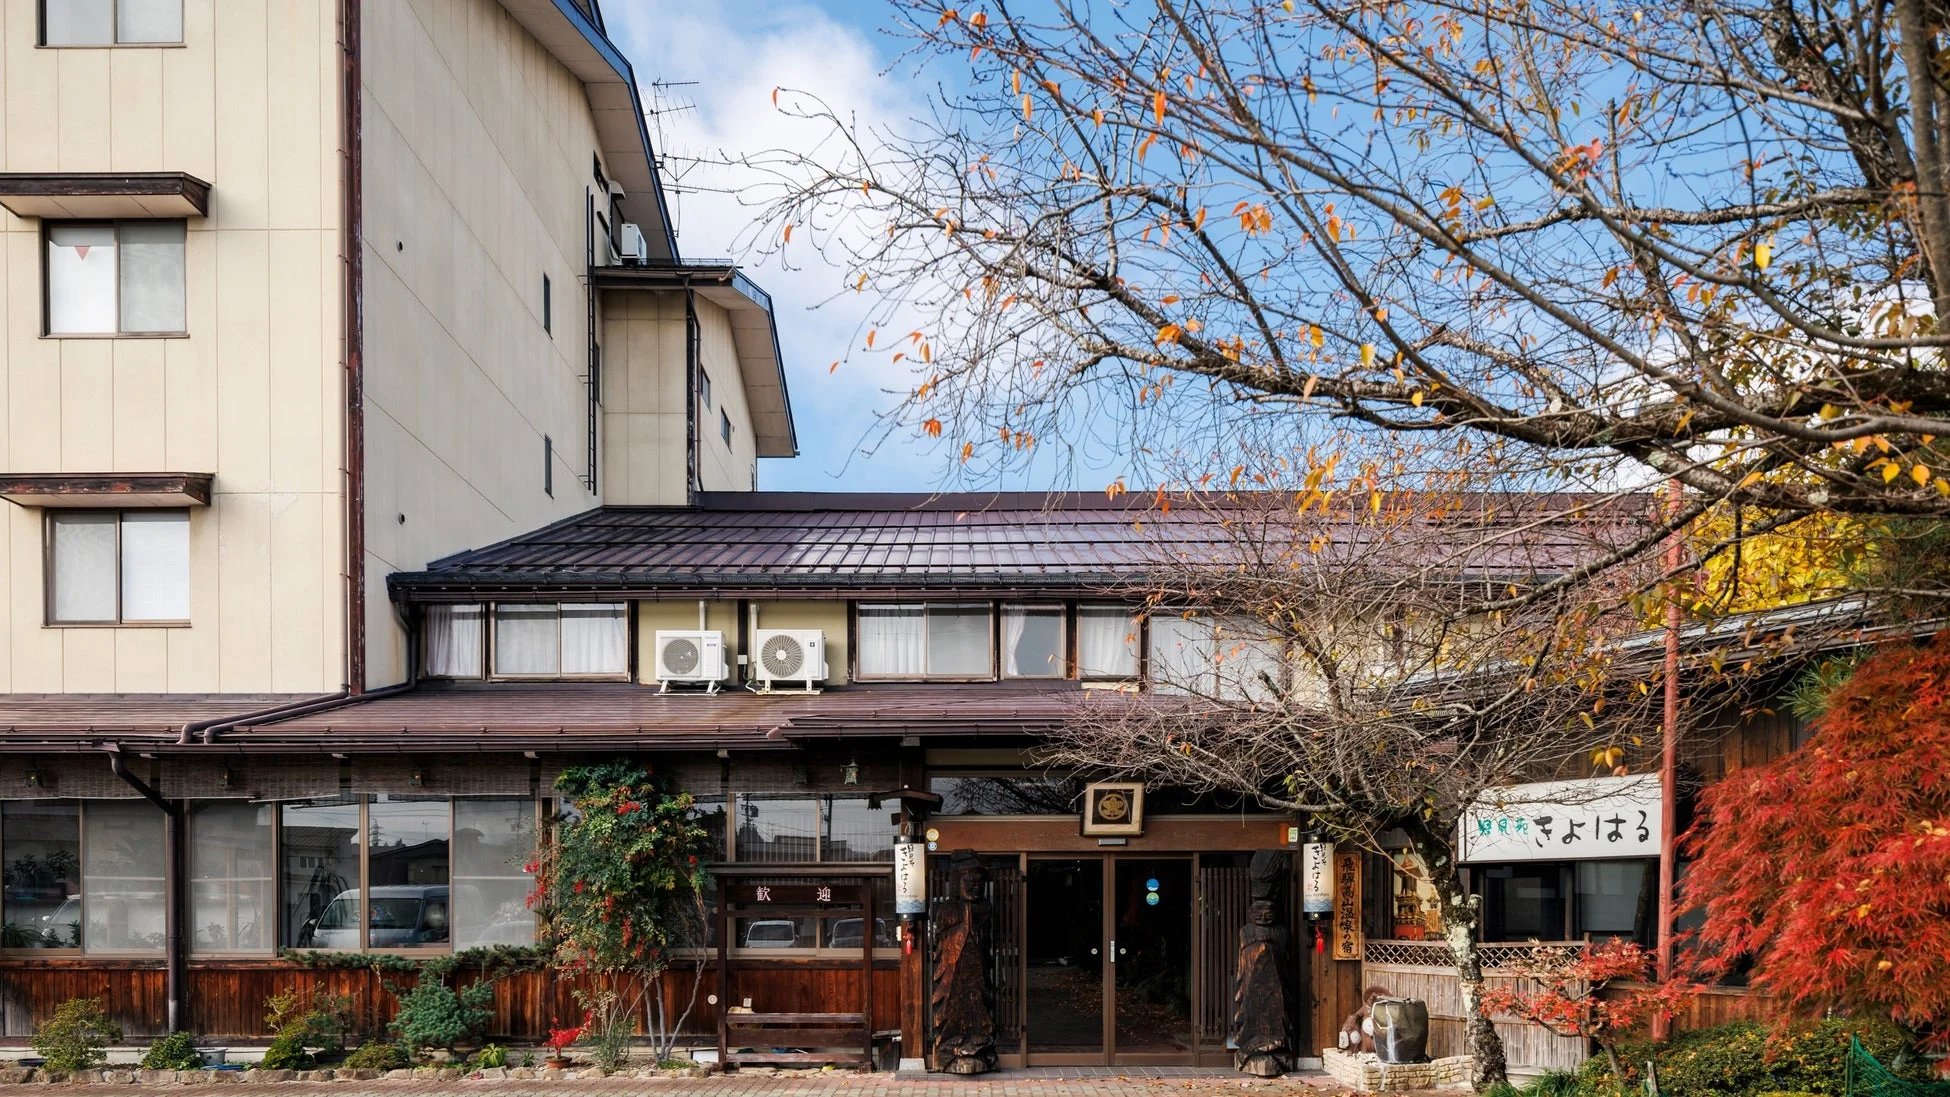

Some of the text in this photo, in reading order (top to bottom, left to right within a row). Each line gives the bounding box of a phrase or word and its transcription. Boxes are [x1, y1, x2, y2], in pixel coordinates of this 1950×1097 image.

[1533, 810, 1650, 848] きよはる
[1311, 845, 1321, 892] きよはる
[1340, 857, 1356, 954] 飛騨高山温泉の宿
